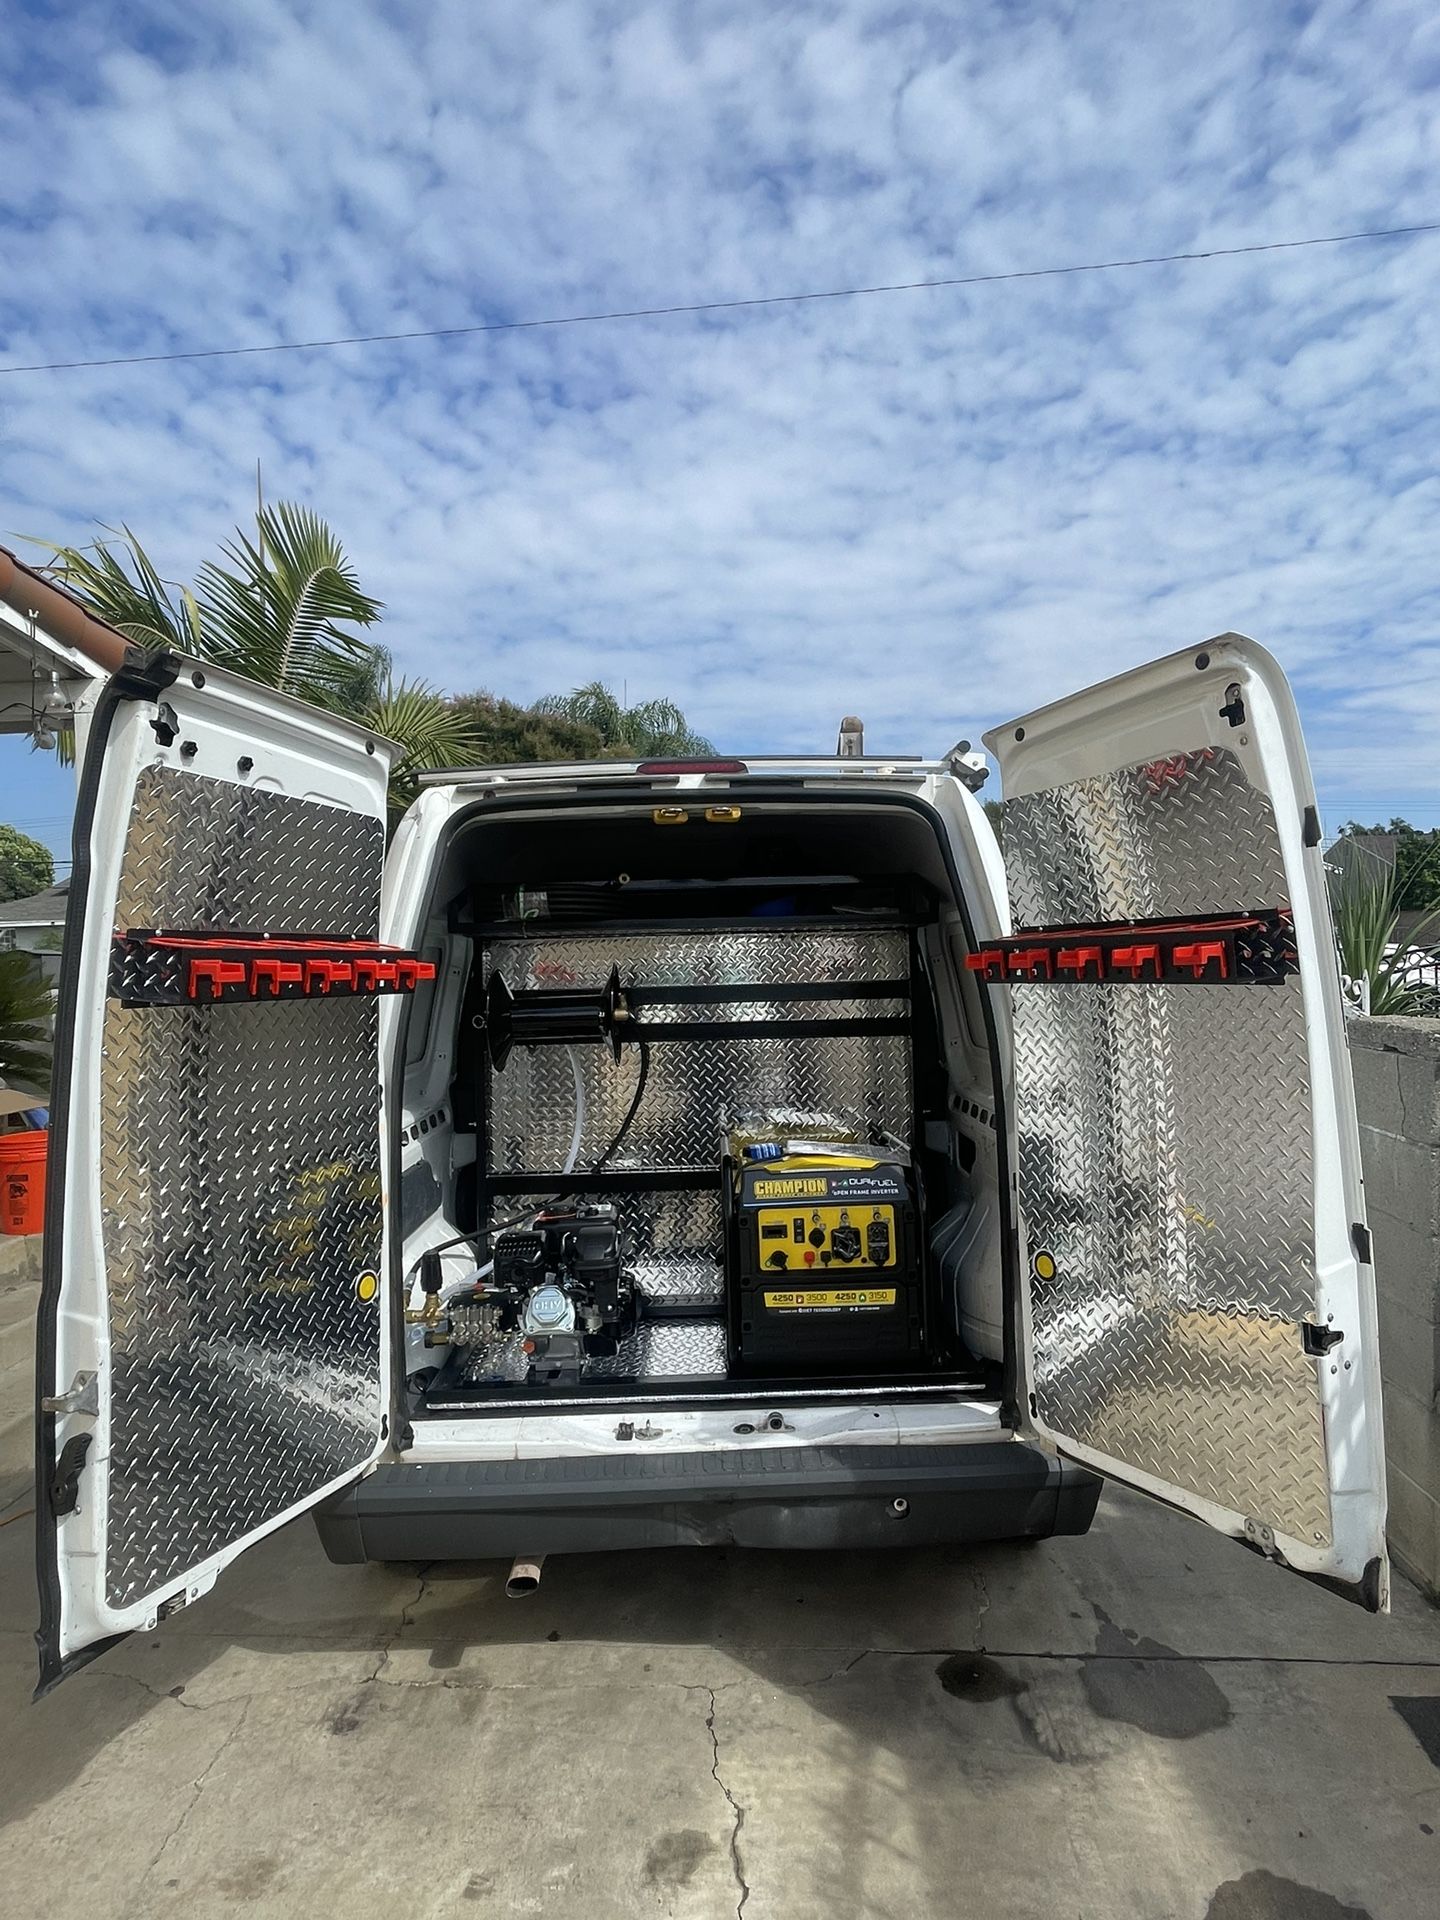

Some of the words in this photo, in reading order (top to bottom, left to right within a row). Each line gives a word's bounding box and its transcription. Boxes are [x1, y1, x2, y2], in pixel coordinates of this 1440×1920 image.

[755, 1178, 827, 1195] CHAMPION
[772, 1294, 794, 1302] 4250
[806, 1293, 828, 1301] 3500
[835, 1292, 857, 1300] 4250
[869, 1291, 888, 1299] 3150
[535, 1300, 562, 1310] OHV
